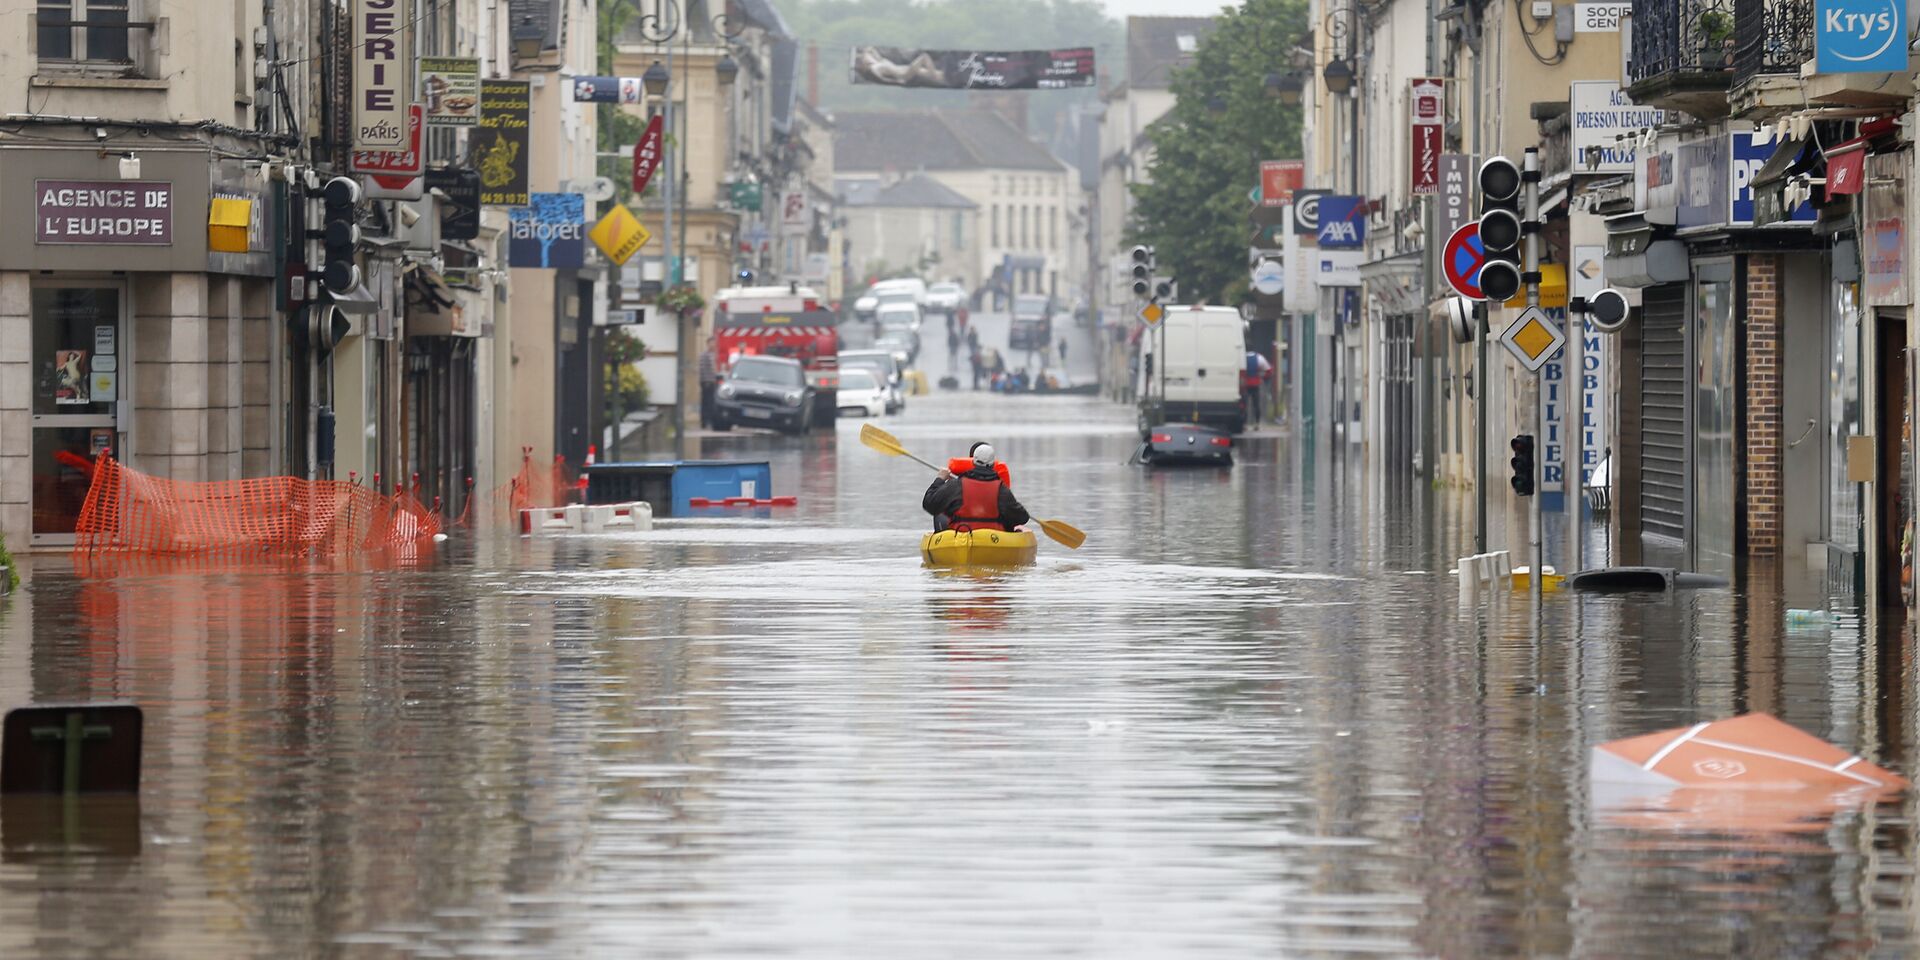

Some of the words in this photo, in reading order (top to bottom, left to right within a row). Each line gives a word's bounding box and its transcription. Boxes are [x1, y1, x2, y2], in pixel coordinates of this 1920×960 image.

[1826, 8, 1891, 40] Krys
[361, 126, 400, 140] PARIS
[1576, 111, 1618, 128] PRESSON
[637, 132, 658, 178] TABAC
[1421, 126, 1434, 183] PIZZA
[1578, 147, 1636, 164] IMOB
[41, 189, 136, 208] AGENCE
[144, 190, 168, 208] DE
[1446, 159, 1463, 235] IMMOBI
[511, 211, 582, 240] laforêt
[1318, 221, 1358, 242] AXA
[613, 229, 646, 260] PRESSE
[1543, 306, 1565, 482] MBILIER
